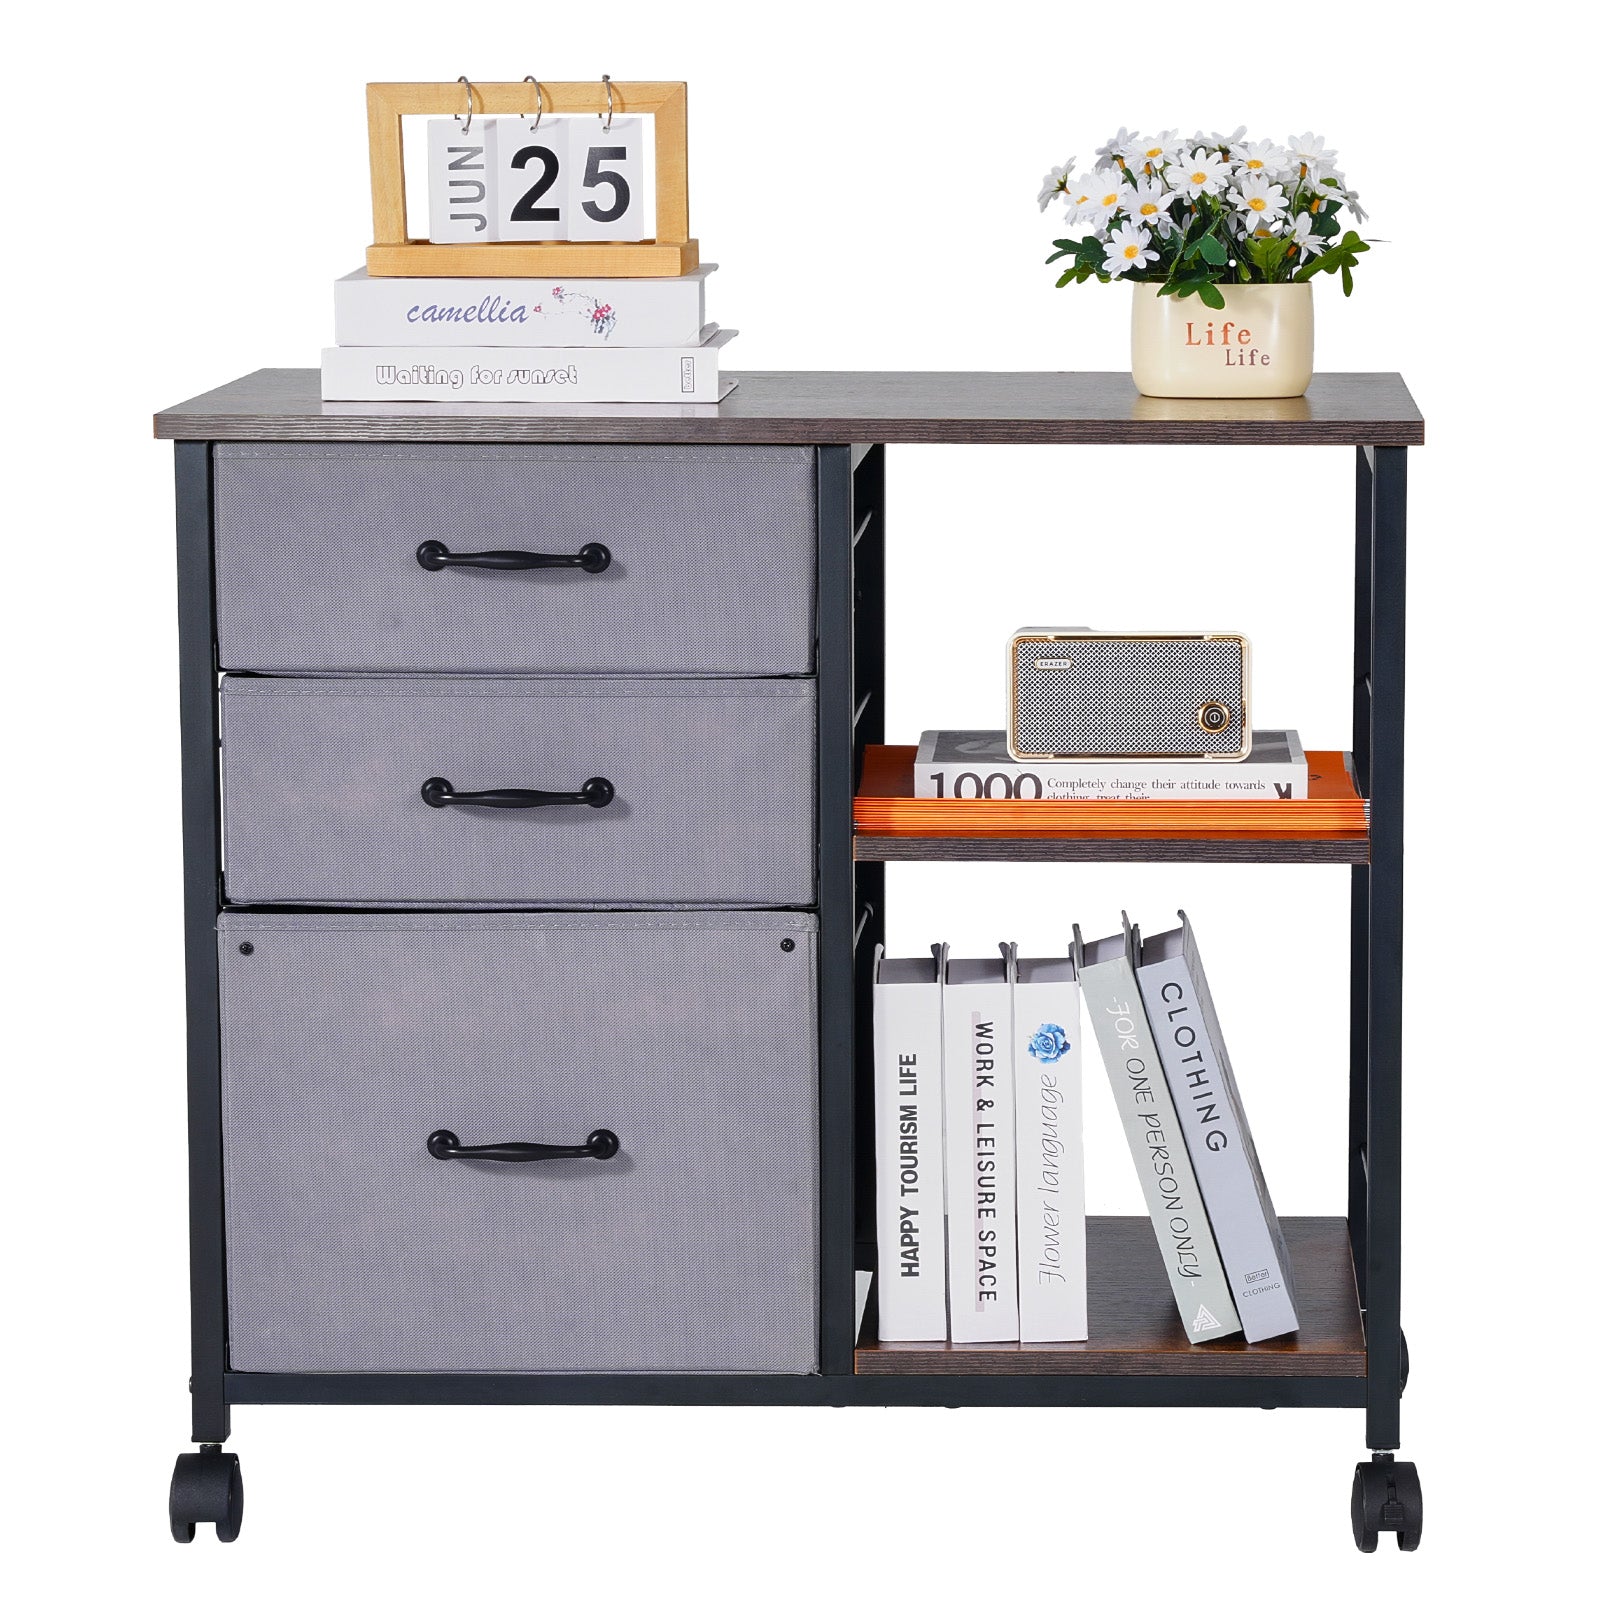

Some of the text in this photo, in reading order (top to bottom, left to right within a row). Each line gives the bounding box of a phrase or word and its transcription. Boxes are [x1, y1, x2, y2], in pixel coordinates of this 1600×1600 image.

[447, 146, 488, 232] JUN
[407, 294, 530, 324] camellia
[1185, 322, 1252, 346] Life
[1225, 349, 1271, 366] Life
[376, 365, 578, 390] Waiting for sunset
[1047, 777, 1266, 792] Completely change their attitude towards
[1126, 1058, 1155, 1105] ONE
[1161, 982, 1228, 1153] CLOTHING
[898, 1053, 919, 1278] HAPPY TOURISM LIFE
[975, 1021, 998, 1302] WORK & LEISURE SPACE
[1037, 1073, 1066, 1284] Flower language
[1137, 1113, 1183, 1210] PERSON
[1242, 1282, 1281, 1298] CLOTHING
